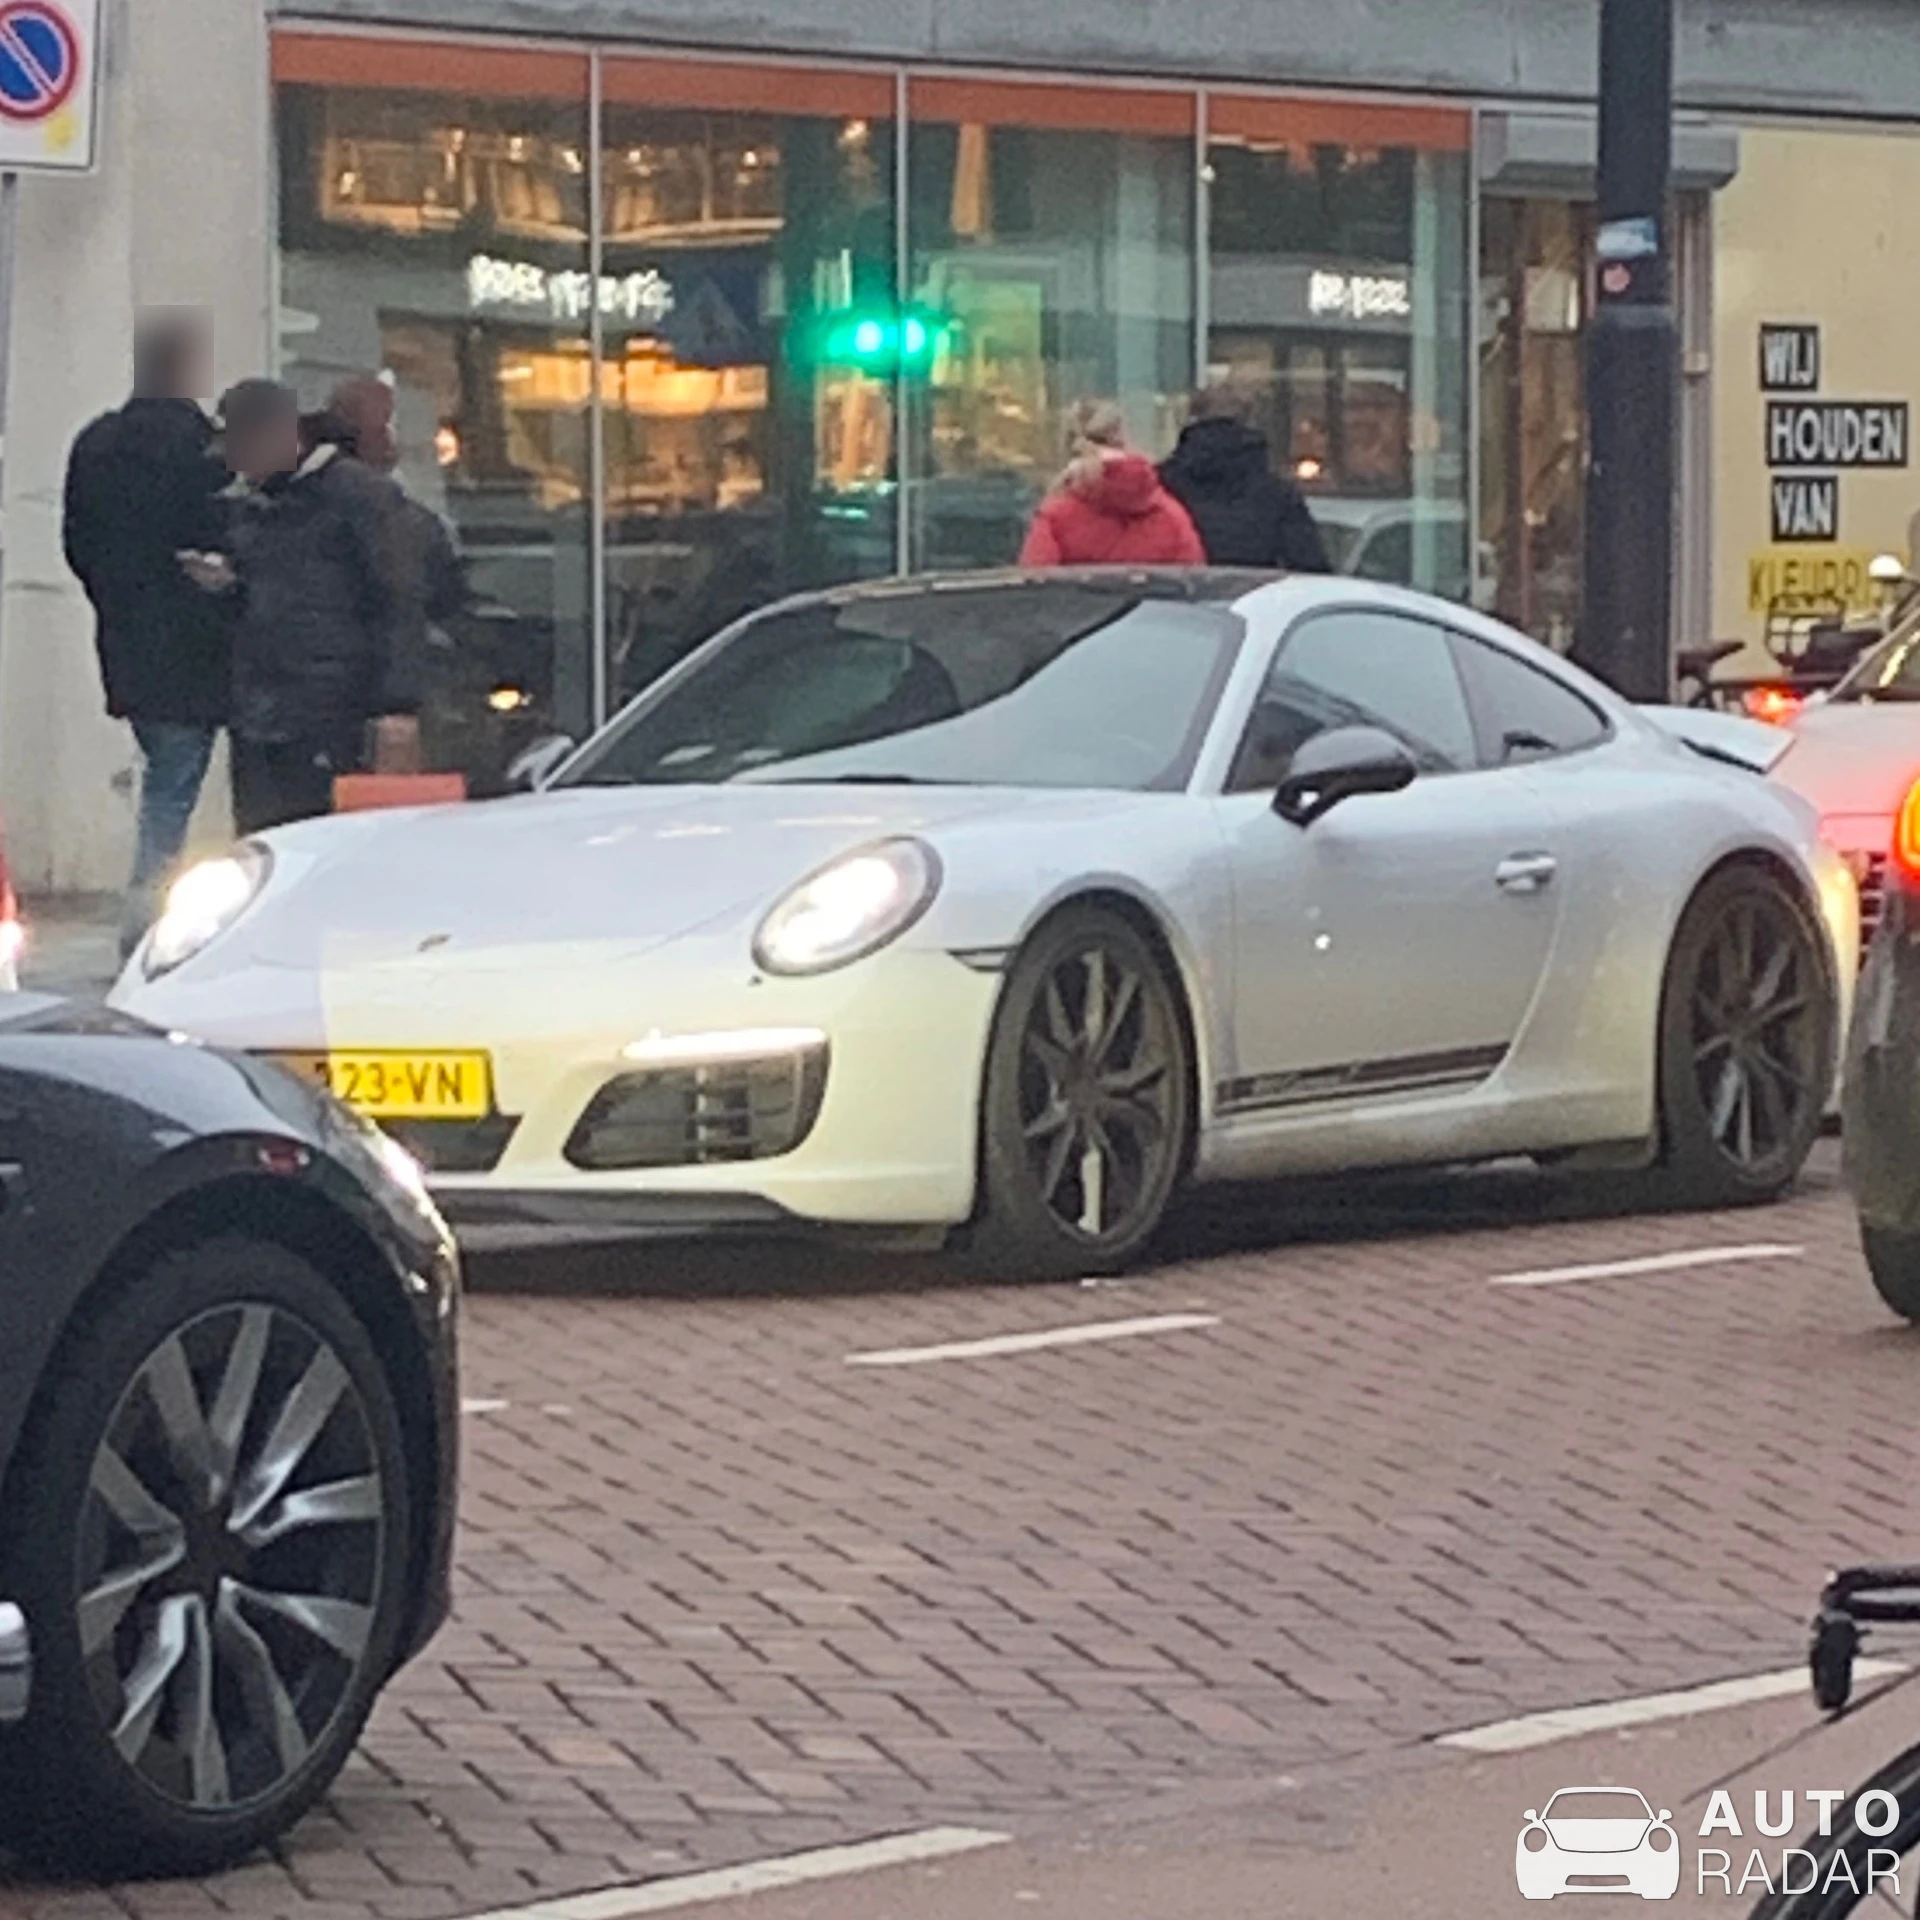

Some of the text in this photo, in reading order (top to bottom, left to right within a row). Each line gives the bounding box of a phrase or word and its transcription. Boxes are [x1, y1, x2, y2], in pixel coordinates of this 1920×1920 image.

[1764, 331, 1815, 384] WIJ
[1771, 408, 1904, 462] HOUDEN
[1774, 481, 1833, 536] VAN
